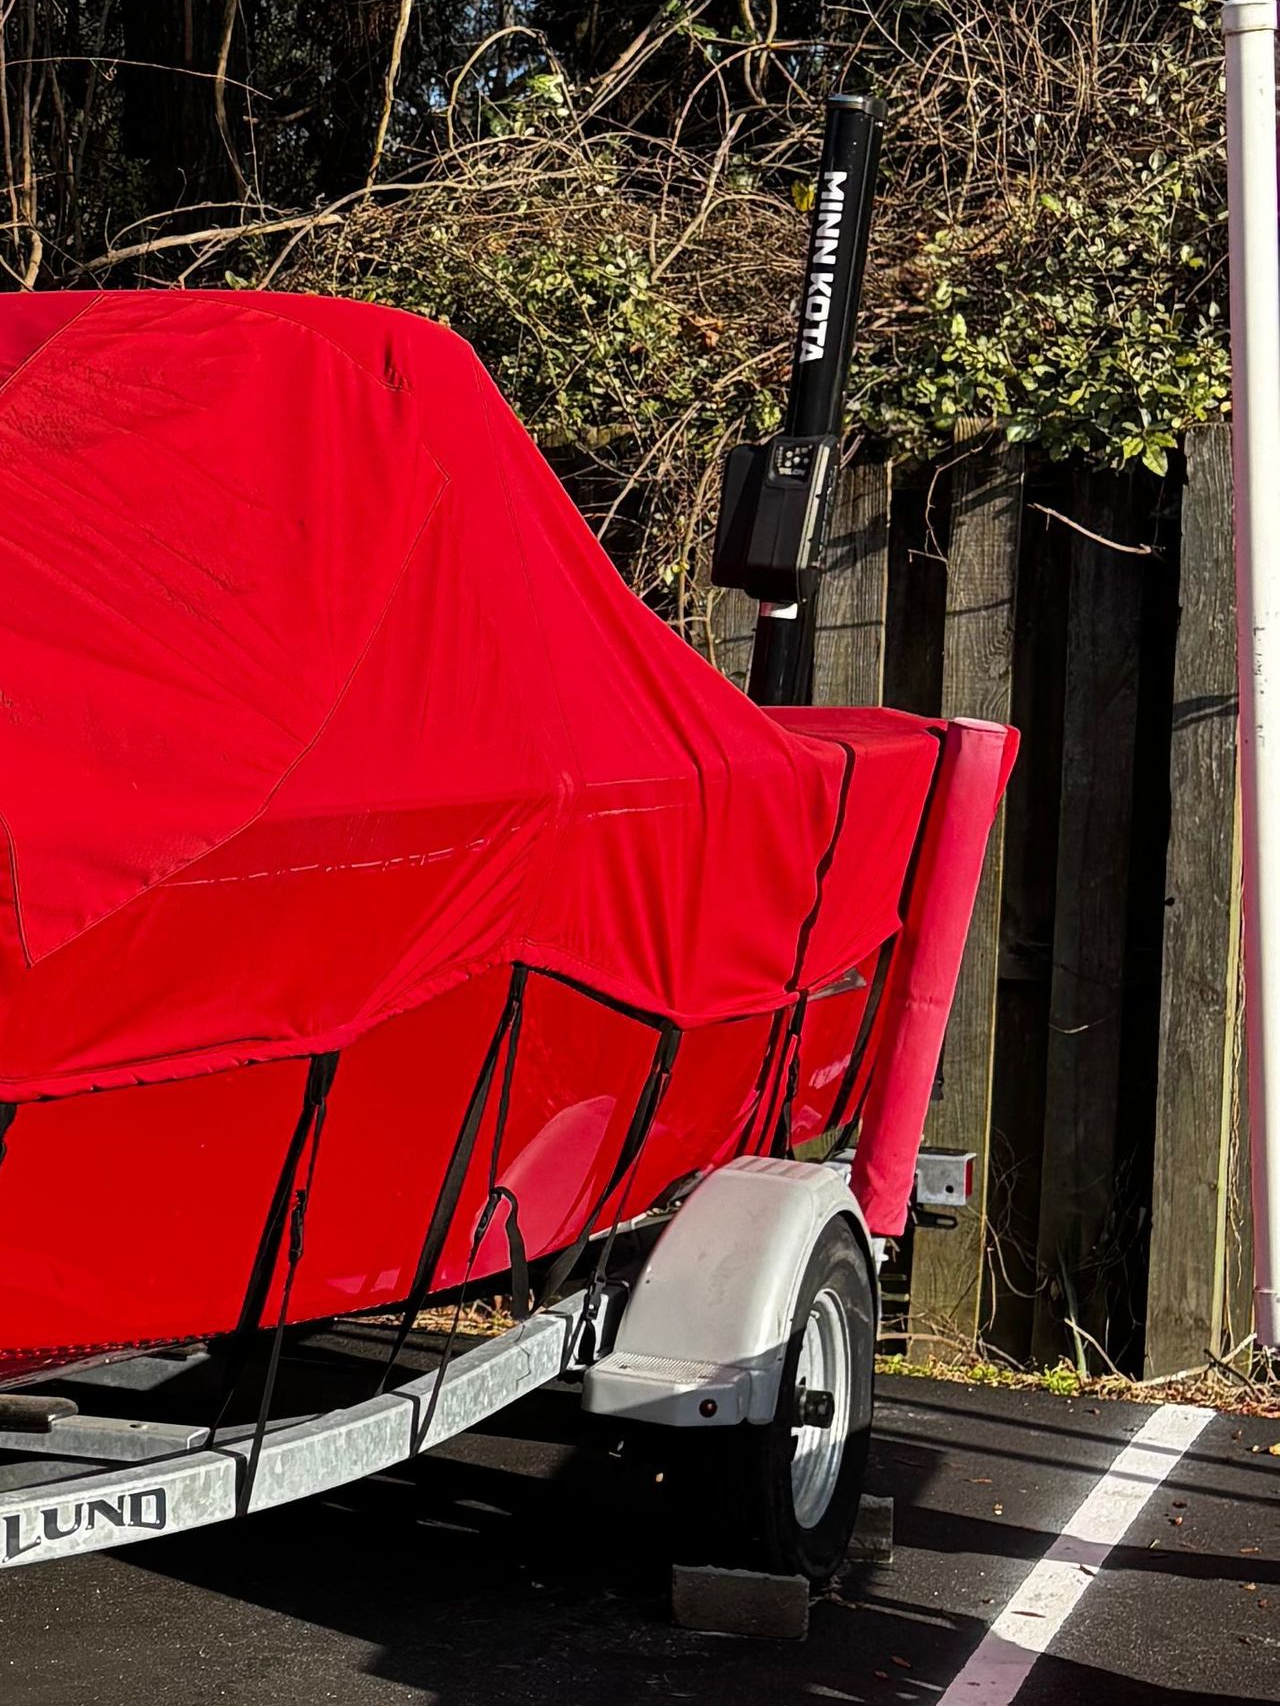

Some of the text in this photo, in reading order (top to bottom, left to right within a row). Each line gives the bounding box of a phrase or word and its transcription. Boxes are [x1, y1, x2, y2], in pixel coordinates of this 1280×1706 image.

[799, 171, 848, 364] MINN KOTA
[2, 1487, 167, 1563] LUND
